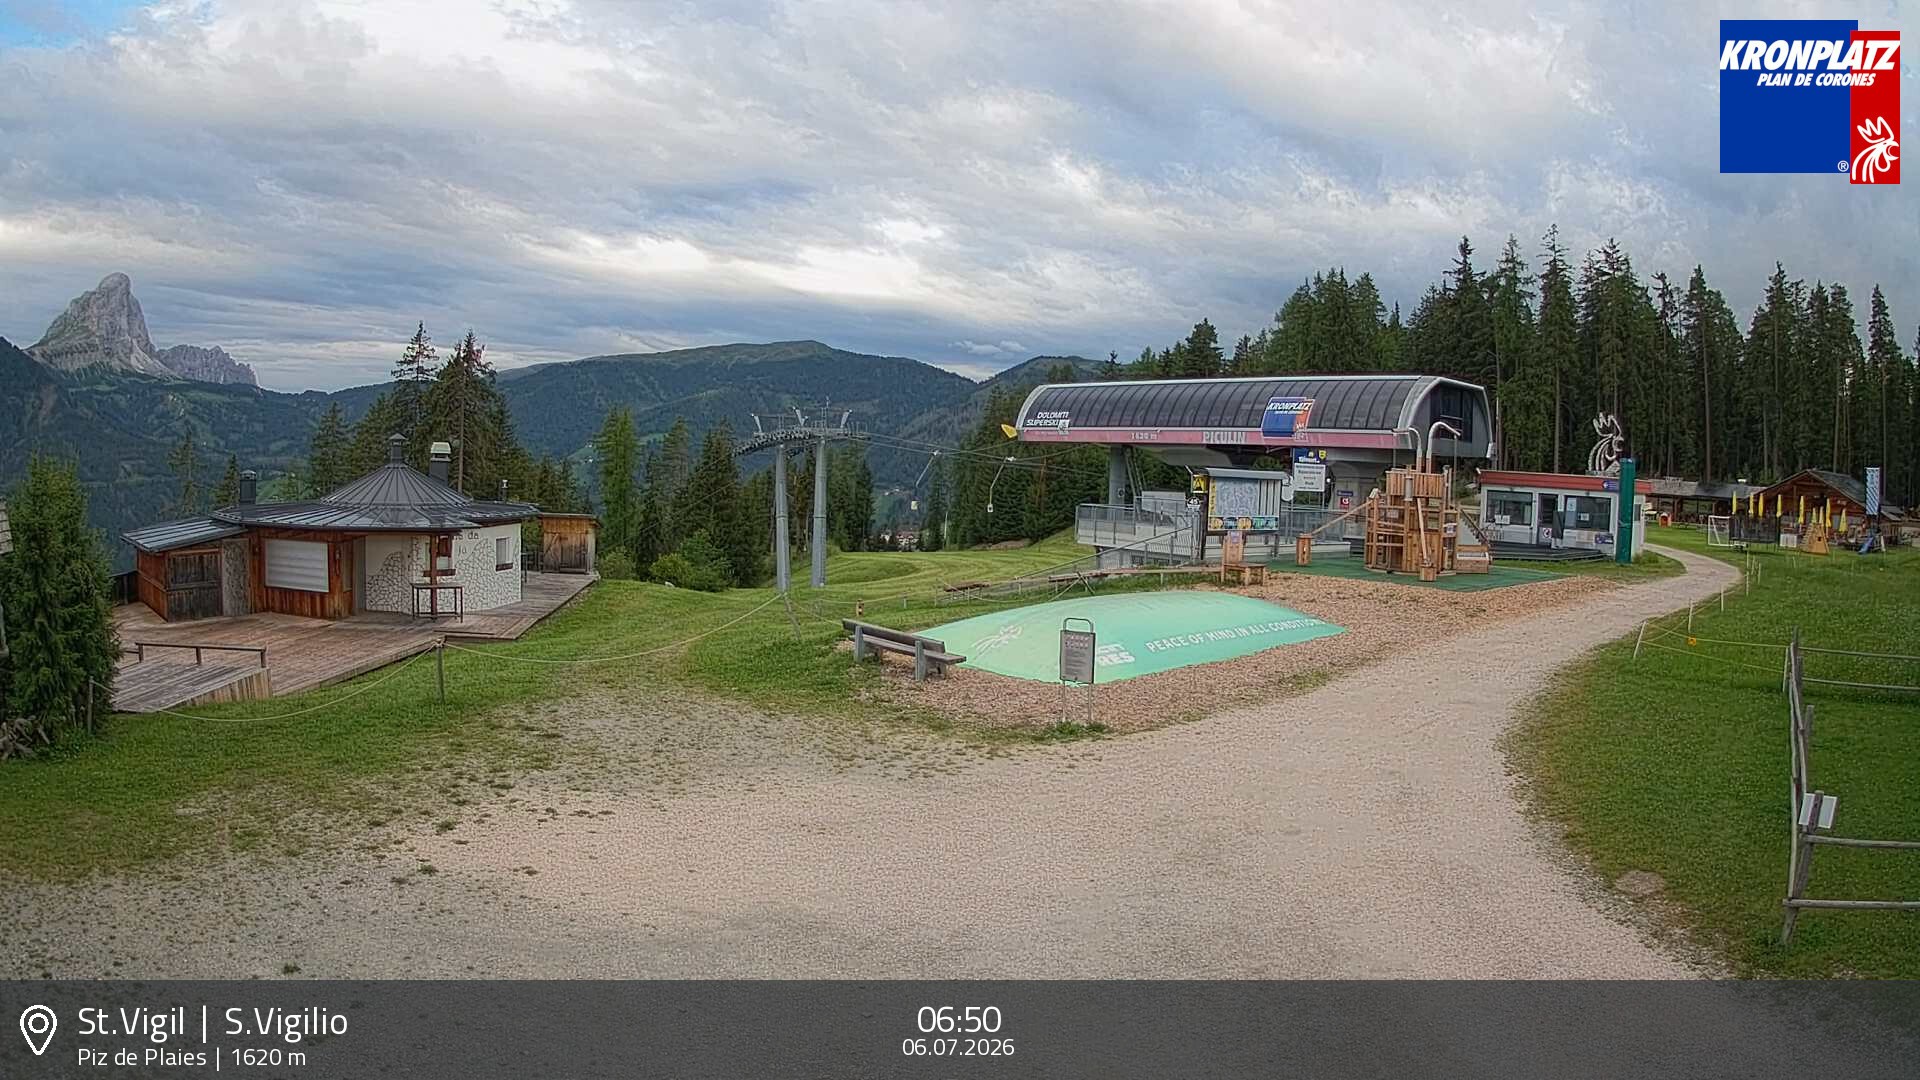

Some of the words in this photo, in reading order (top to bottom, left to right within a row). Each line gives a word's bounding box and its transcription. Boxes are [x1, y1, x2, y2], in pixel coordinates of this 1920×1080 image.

[1036, 411, 1070, 419] DOLOMITI
[1202, 431, 1247, 444] PICULIN
[1145, 636, 1190, 653] PEACE
[1188, 633, 1205, 644] OF
[1205, 629, 1237, 642] MIND
[1235, 626, 1250, 638] IN
[1249, 623, 1270, 635] ALL
